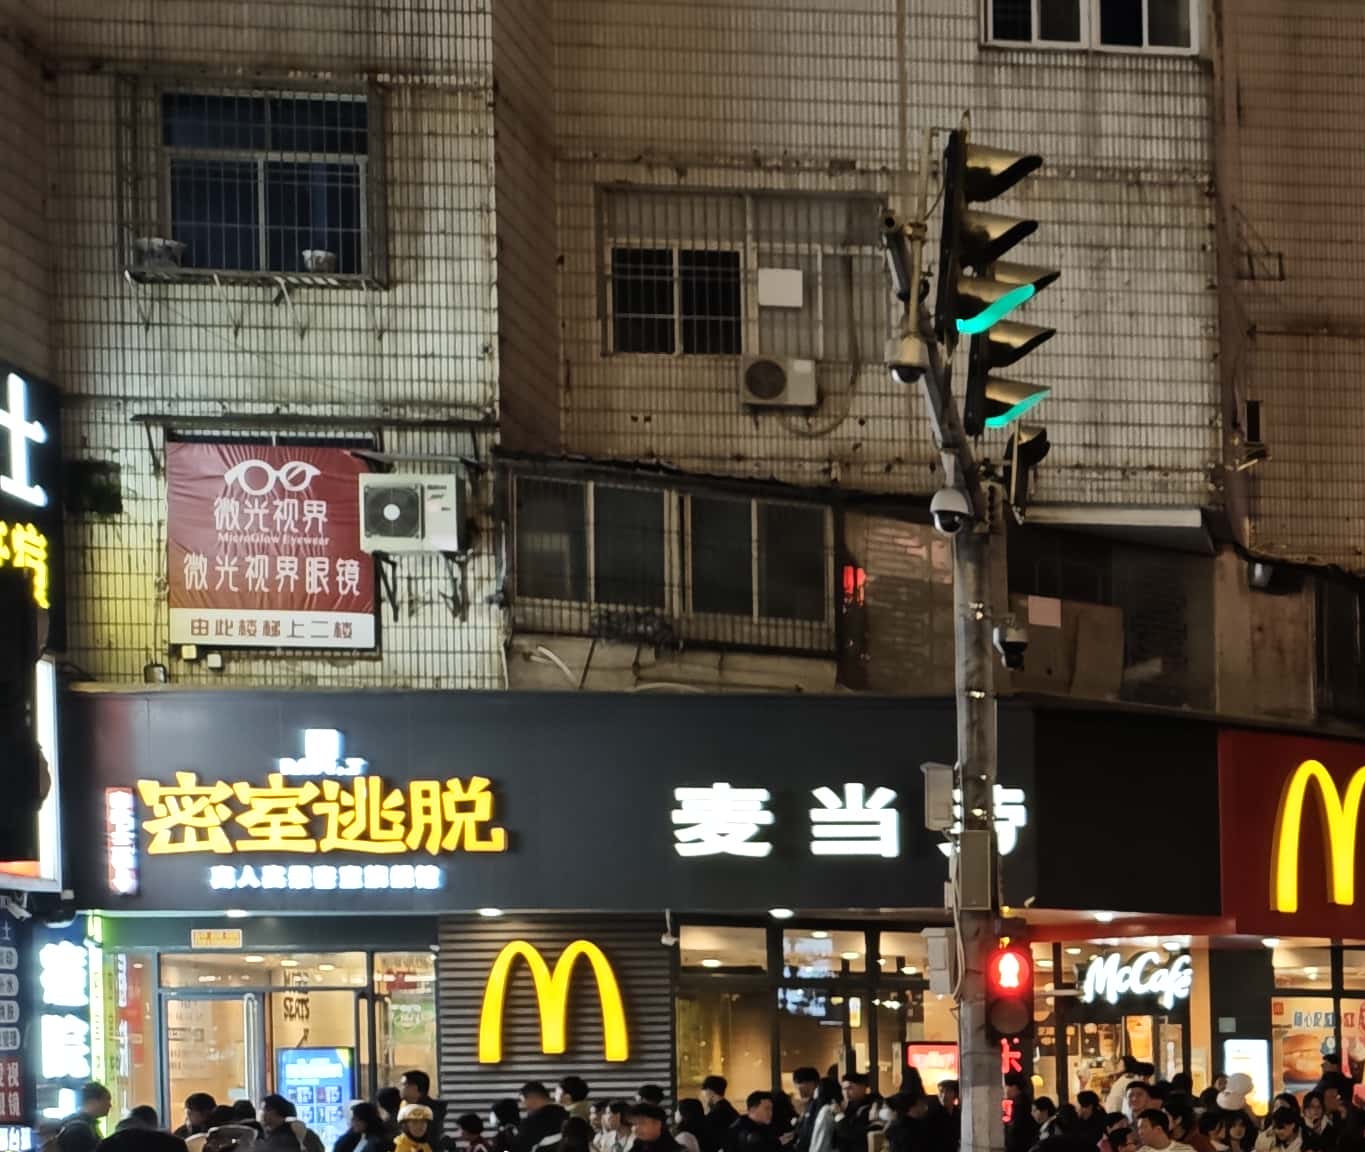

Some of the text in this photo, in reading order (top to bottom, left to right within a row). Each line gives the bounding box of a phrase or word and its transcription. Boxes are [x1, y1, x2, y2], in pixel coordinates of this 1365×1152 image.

[213, 496, 328, 534] 微光视界
[282, 533, 330, 546] Eyewear
[183, 552, 361, 597] 微光视界眼镜
[190, 619, 354, 640] 由此楼梯上二楼
[136, 771, 508, 856] 密室逃脱
